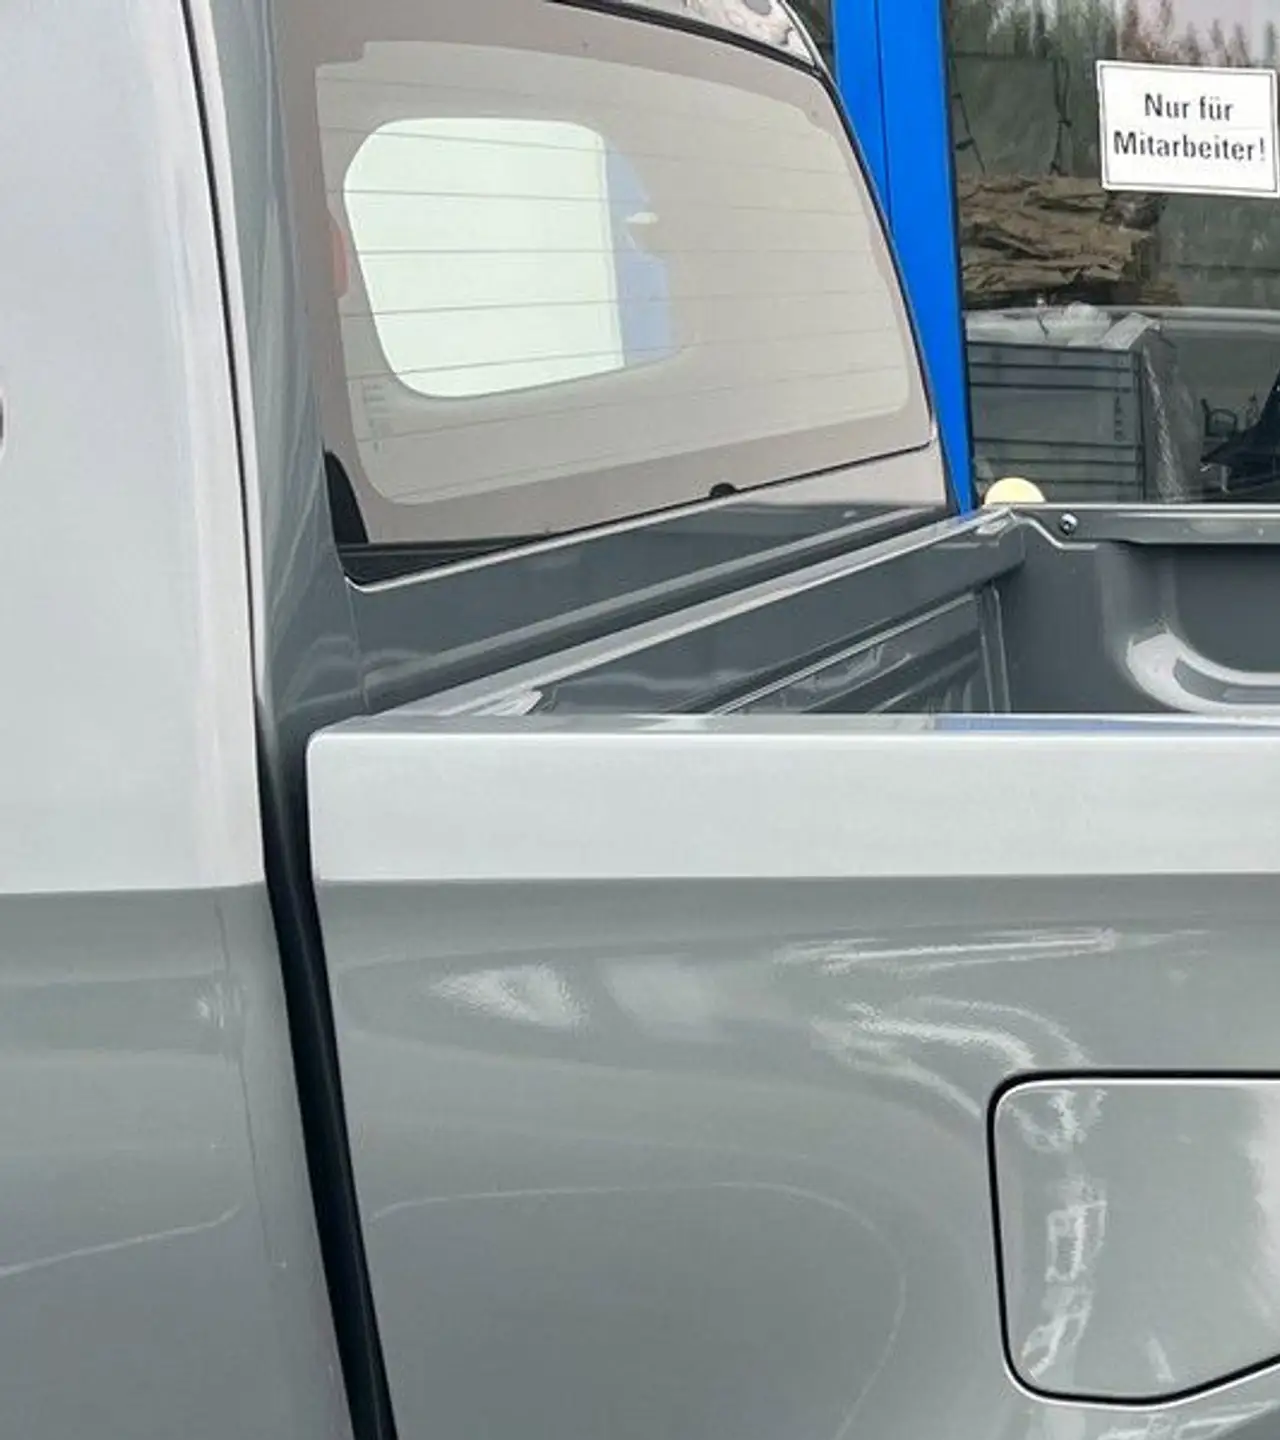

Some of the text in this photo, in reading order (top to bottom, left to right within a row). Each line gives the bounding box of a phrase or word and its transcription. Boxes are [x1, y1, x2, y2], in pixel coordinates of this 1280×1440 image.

[1144, 92, 1234, 121] Nur für
[1113, 130, 1266, 161] Mitarbeiter!
